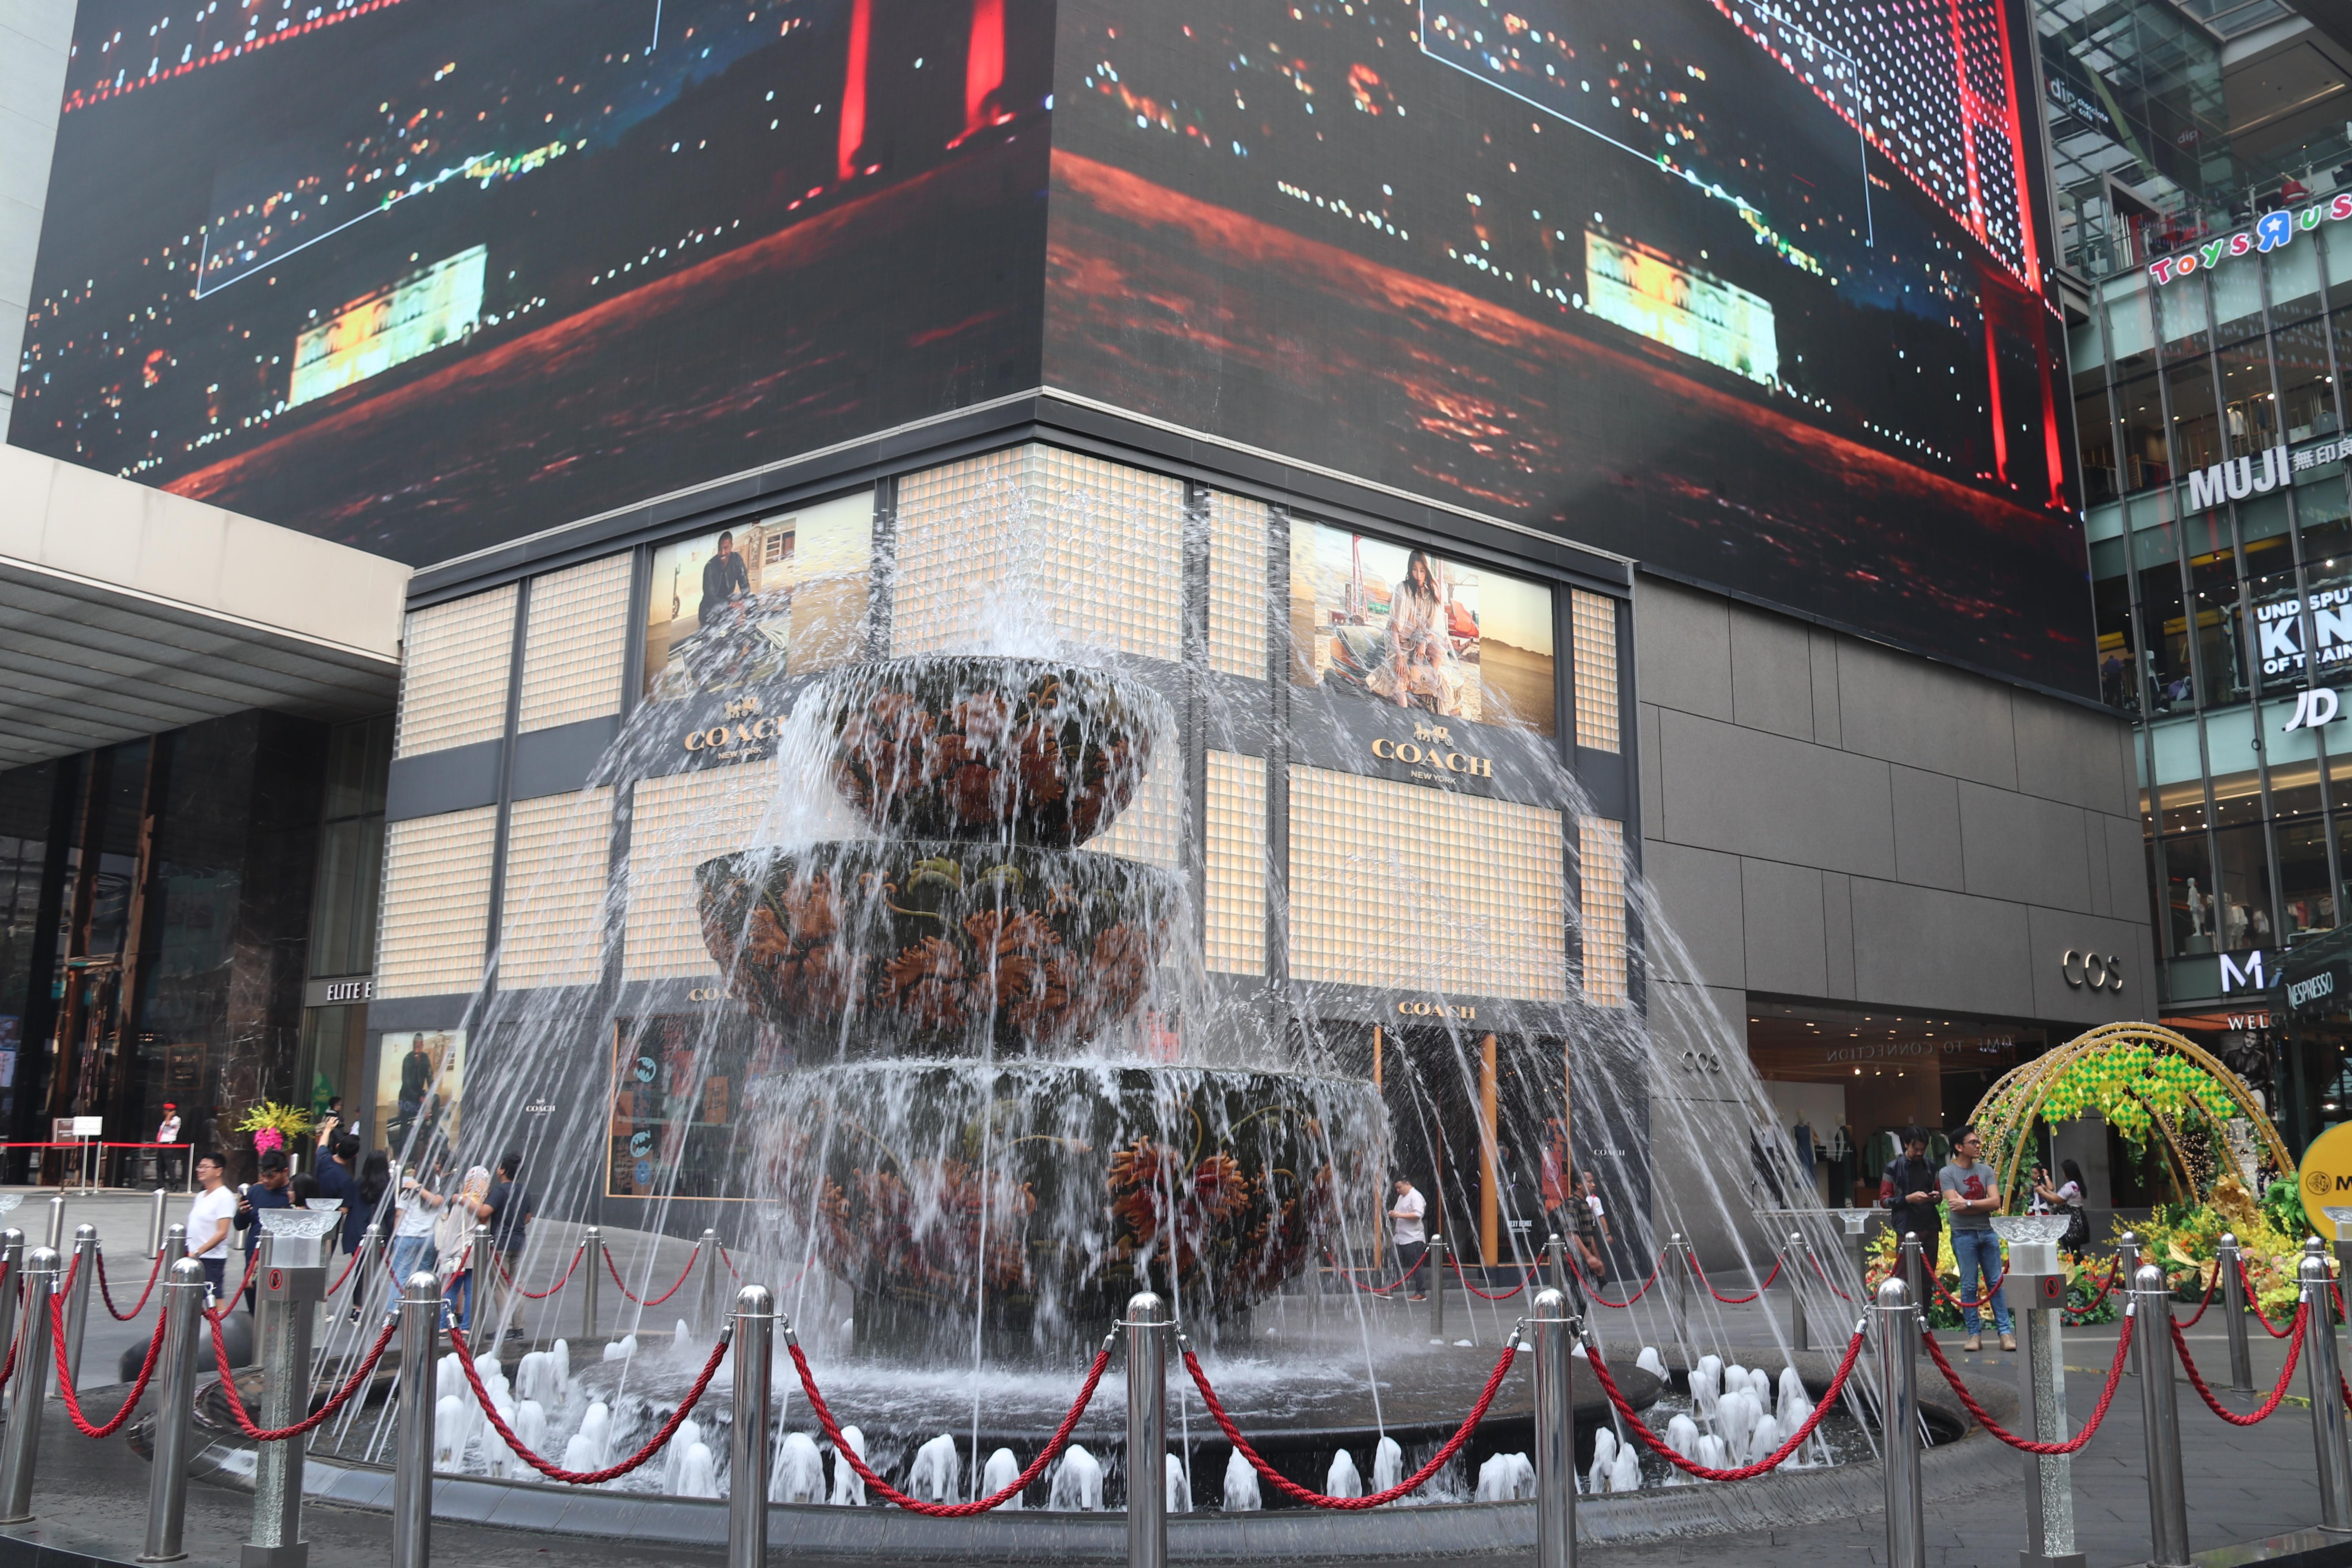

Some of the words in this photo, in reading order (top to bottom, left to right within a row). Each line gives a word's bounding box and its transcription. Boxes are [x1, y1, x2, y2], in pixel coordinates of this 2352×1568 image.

[2051, 78, 2077, 112] dip
[2178, 131, 2197, 144] dip
[2188, 445, 2291, 510] MUJI
[2257, 586, 2352, 622] UNDSPU
[2263, 657, 2290, 675] OF
[2285, 687, 2339, 733] JD
[718, 750, 738, 760] NEW
[739, 746, 763, 755] YORK
[1372, 739, 1492, 778] COACH
[1411, 770, 1432, 780] NEW
[1433, 775, 1457, 784] YORK
[2062, 950, 2123, 992] COS
[327, 982, 361, 1001] ELITE
[2285, 971, 2334, 1010] NESPRESSO
[1398, 1001, 1476, 1019] COACH
[1682, 1051, 1720, 1074] COS
